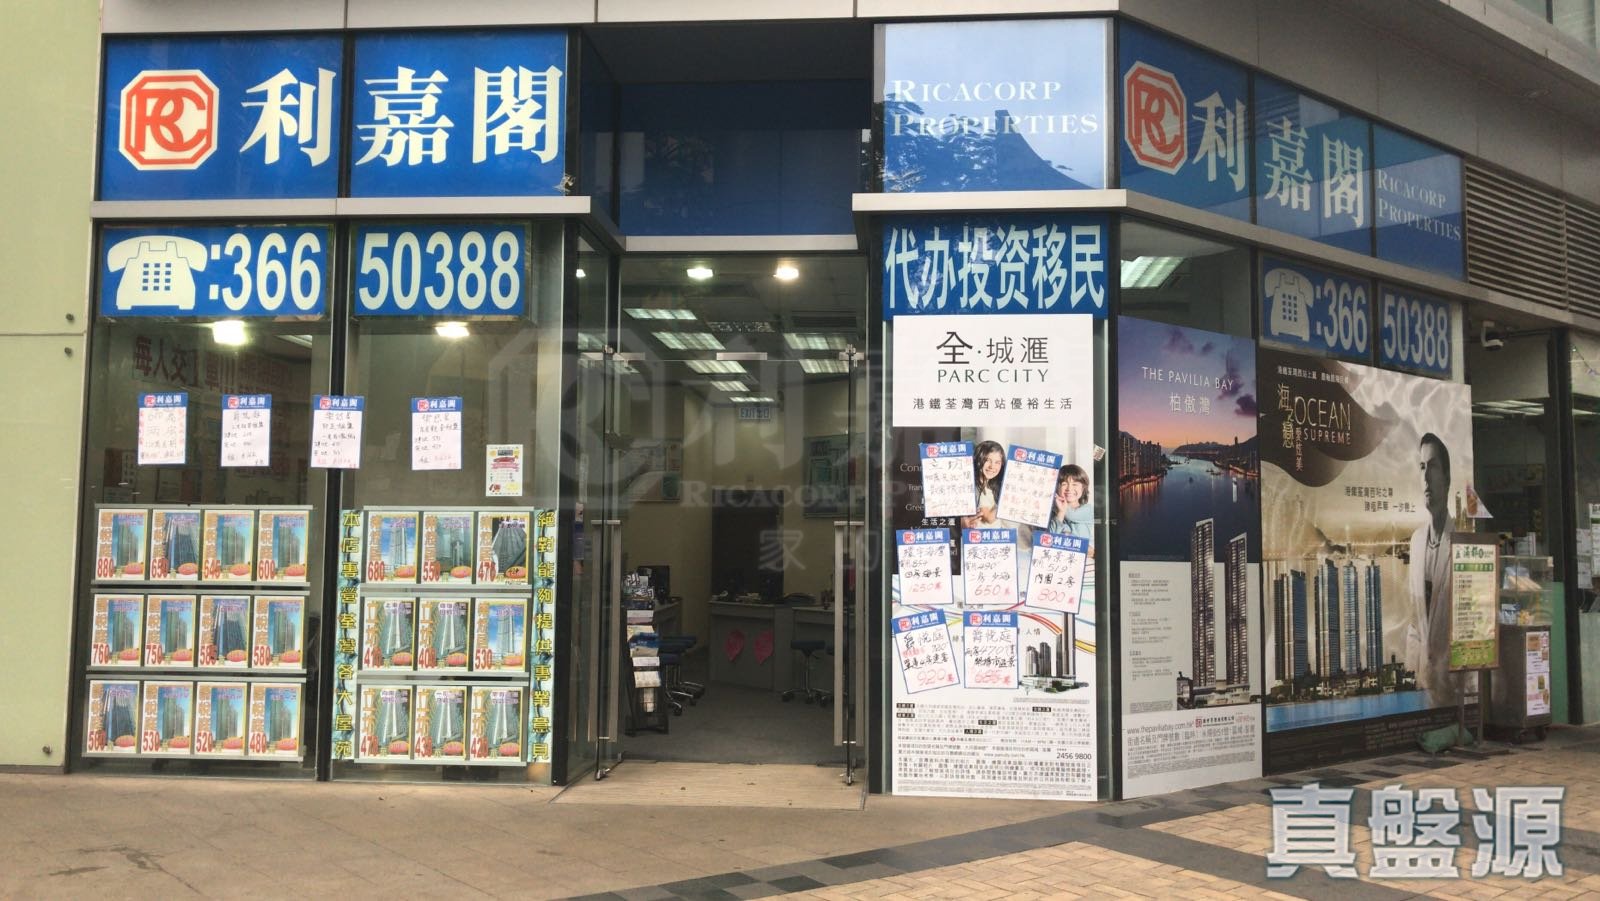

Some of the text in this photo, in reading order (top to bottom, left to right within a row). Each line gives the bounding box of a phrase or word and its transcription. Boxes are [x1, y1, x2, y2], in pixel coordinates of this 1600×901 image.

[892, 79, 1062, 102] RICACORP
[239, 65, 562, 167] 利嘉閣
[892, 113, 1099, 136] PROPERTIES
[1192, 91, 1365, 228] 利嘉閣
[1376, 169, 1447, 208] RICACORP
[1377, 198, 1462, 242] PROPERTIES
[359, 231, 521, 311] 50388
[885, 222, 1105, 309] 代办投资移民
[1383, 293, 1449, 370] 50388
[937, 368, 1049, 384] PARC CITY
[1141, 366, 1235, 391] THE PAVILIA BAY
[912, 397, 1073, 410] 港鐵荃灣西站優裕生活
[1169, 391, 1211, 416] 柏傲灣
[1293, 395, 1351, 431] OCEAN
[1303, 427, 1351, 446] SUPREME
[367, 561, 385, 581] 680
[335, 512, 361, 757] 本店專營荃灣各大屋苑
[532, 512, 555, 760] 絕對能夠提供專業意見
[474, 648, 493, 669] 530
[1056, 752, 1074, 760] 2456
